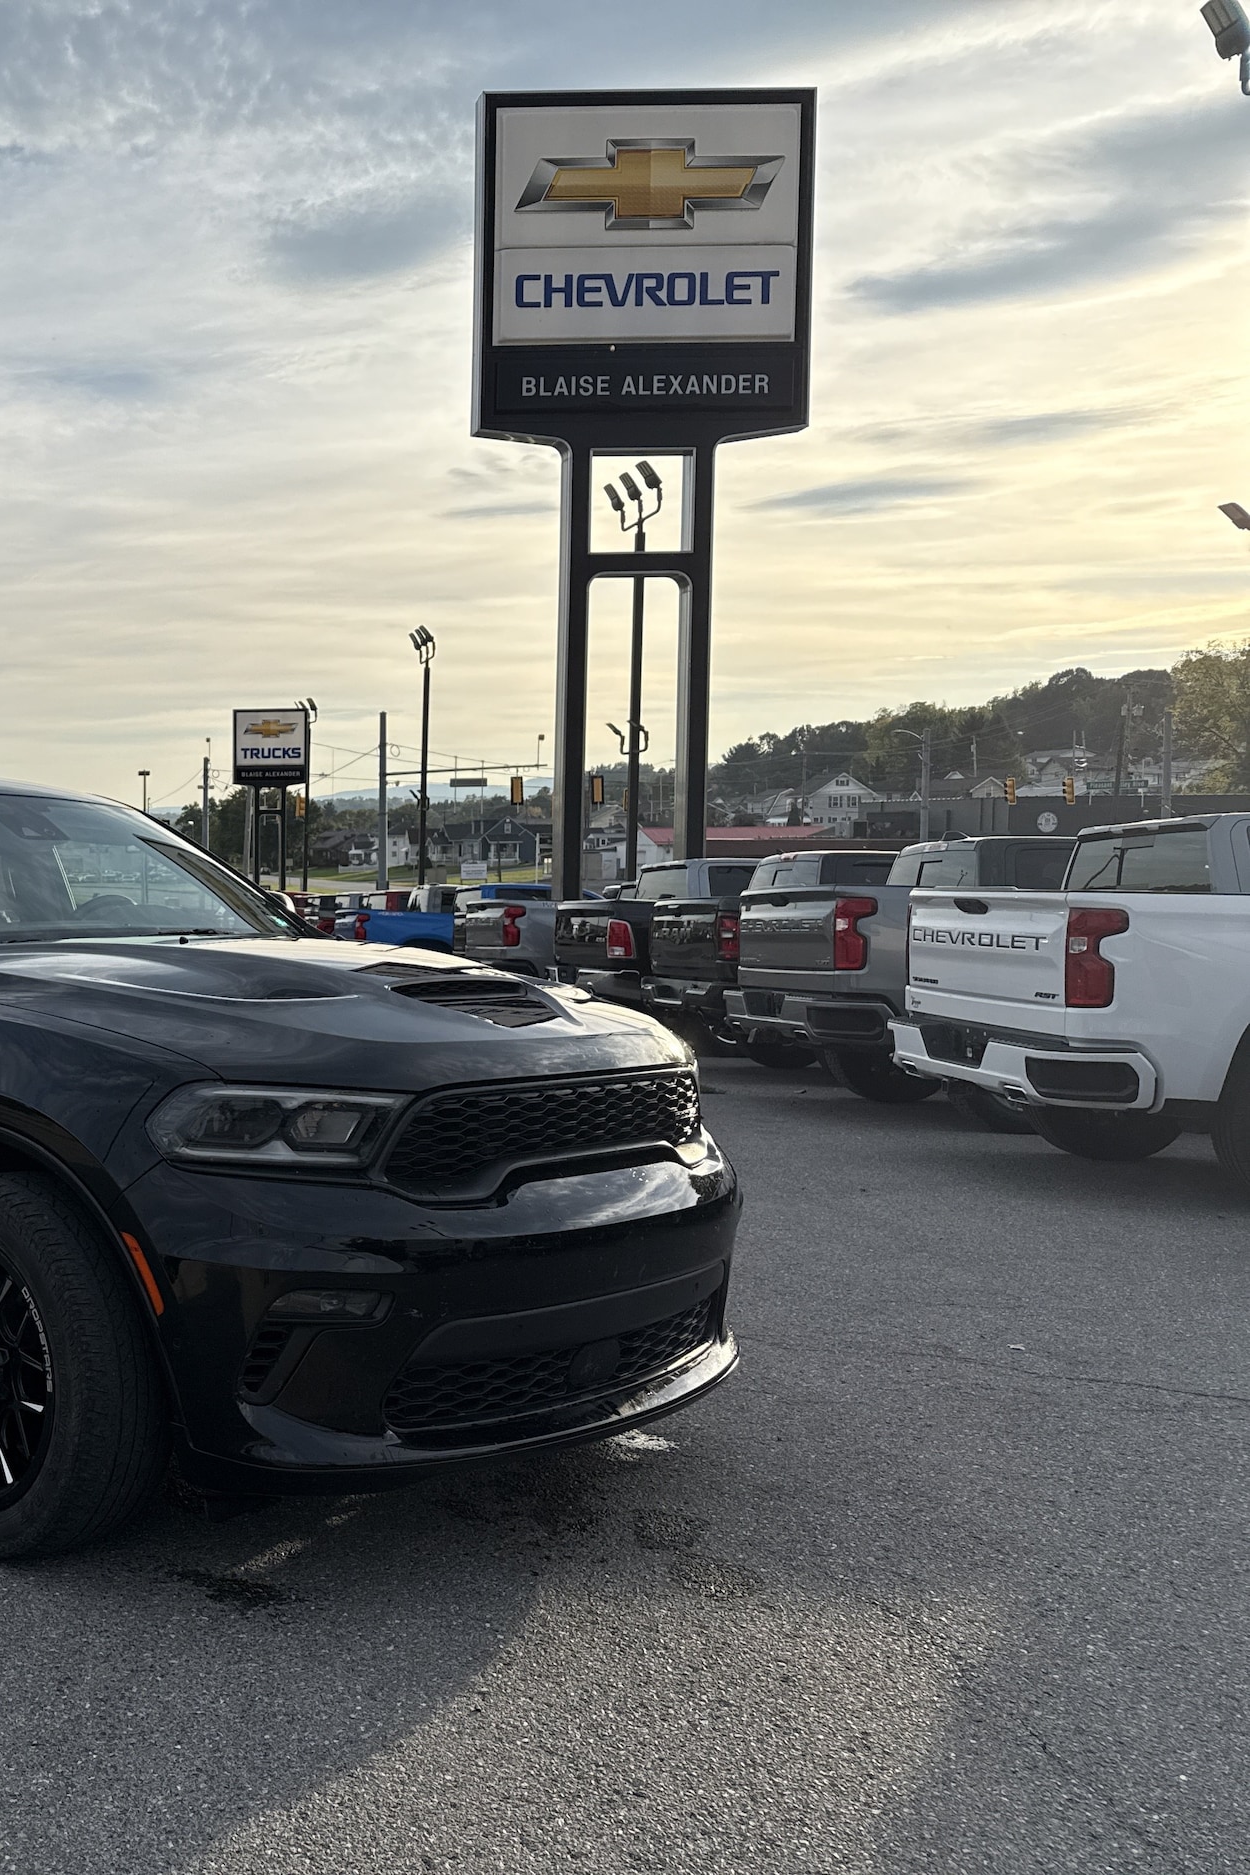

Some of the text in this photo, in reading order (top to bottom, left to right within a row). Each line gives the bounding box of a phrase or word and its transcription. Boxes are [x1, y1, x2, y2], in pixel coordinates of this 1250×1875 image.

[515, 270, 780, 307] CHEVROLET
[521, 374, 769, 397] BLAISE ALEXANDER
[241, 747, 301, 759] TRUCKS
[912, 928, 1047, 951] CHEVROLET
[1034, 991, 1060, 1000] RST
[21, 1286, 53, 1393] DROPSTARS
